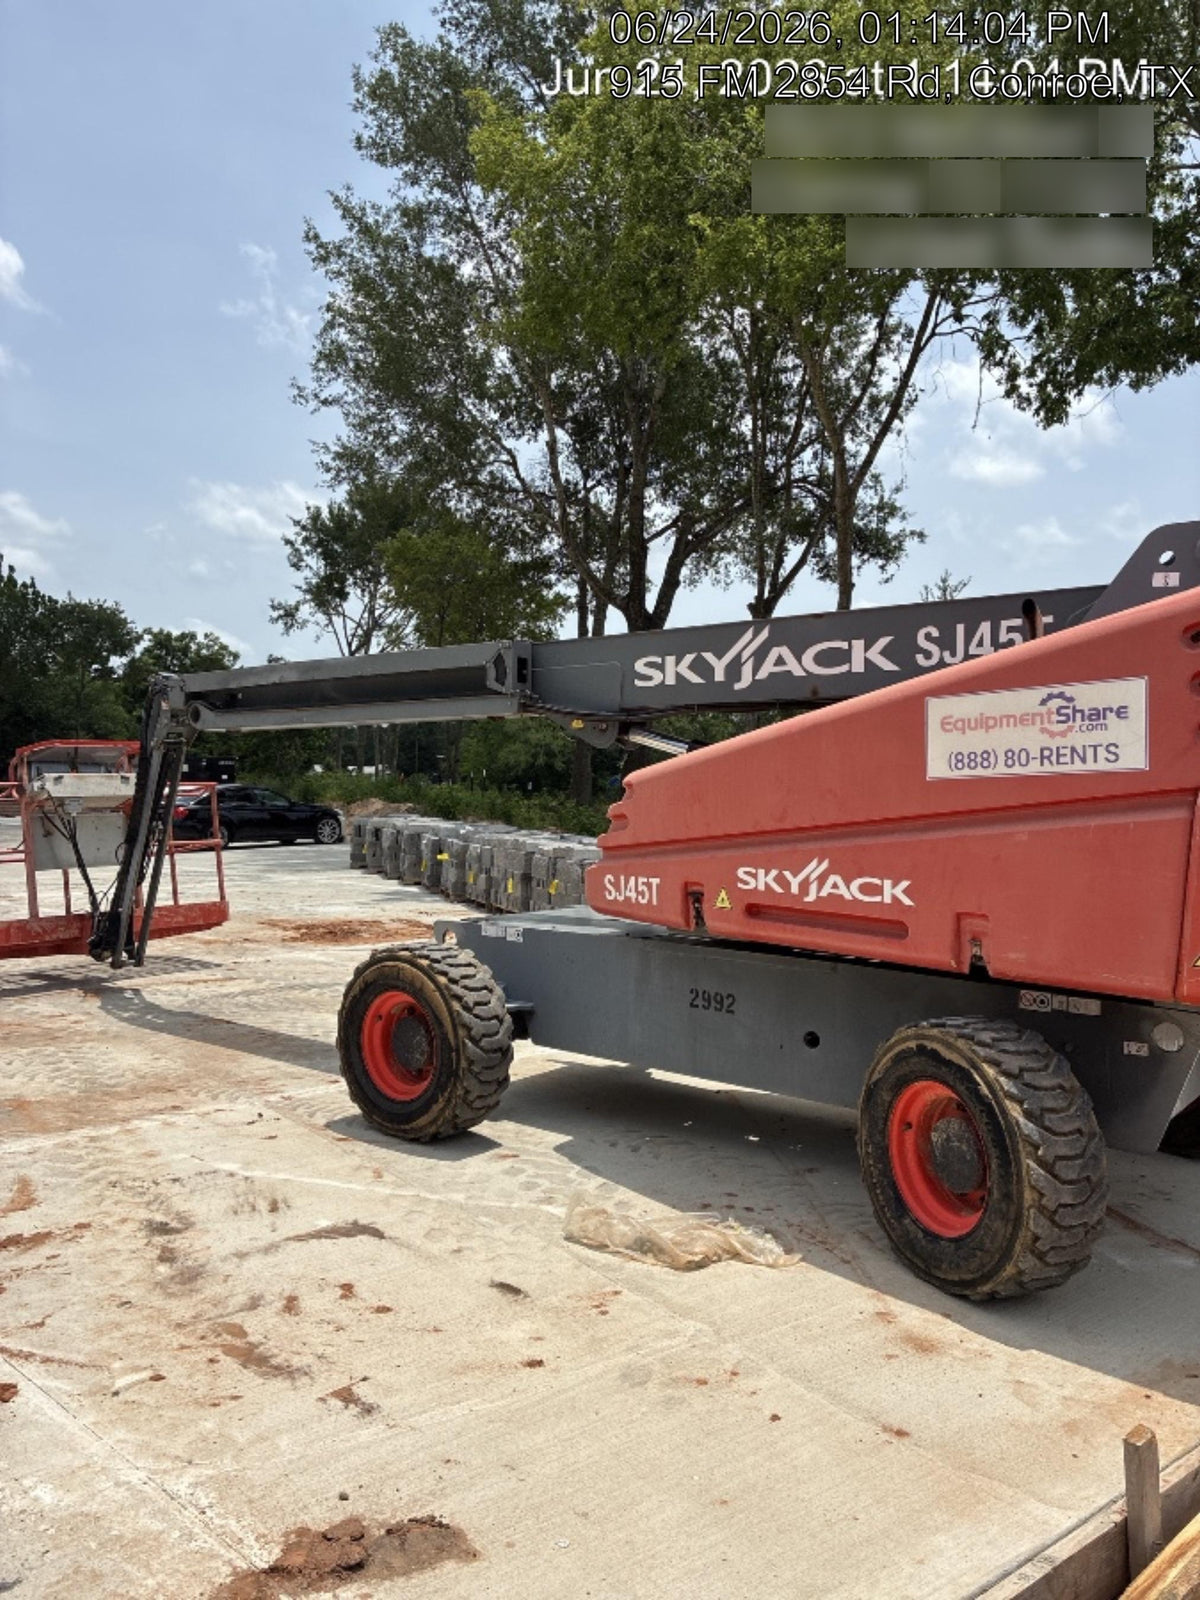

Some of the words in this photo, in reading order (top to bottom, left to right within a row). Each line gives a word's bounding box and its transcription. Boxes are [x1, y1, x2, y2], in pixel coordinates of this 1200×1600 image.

[633, 624, 901, 690] SKYJACK
[939, 704, 1129, 735] EquipmentShare
[948, 749, 999, 772] (888)
[1003, 742, 1120, 769] 80-RENTS
[604, 874, 660, 905] SJ45T
[736, 857, 914, 906] SKYJACK
[689, 987, 736, 1015] 2992
